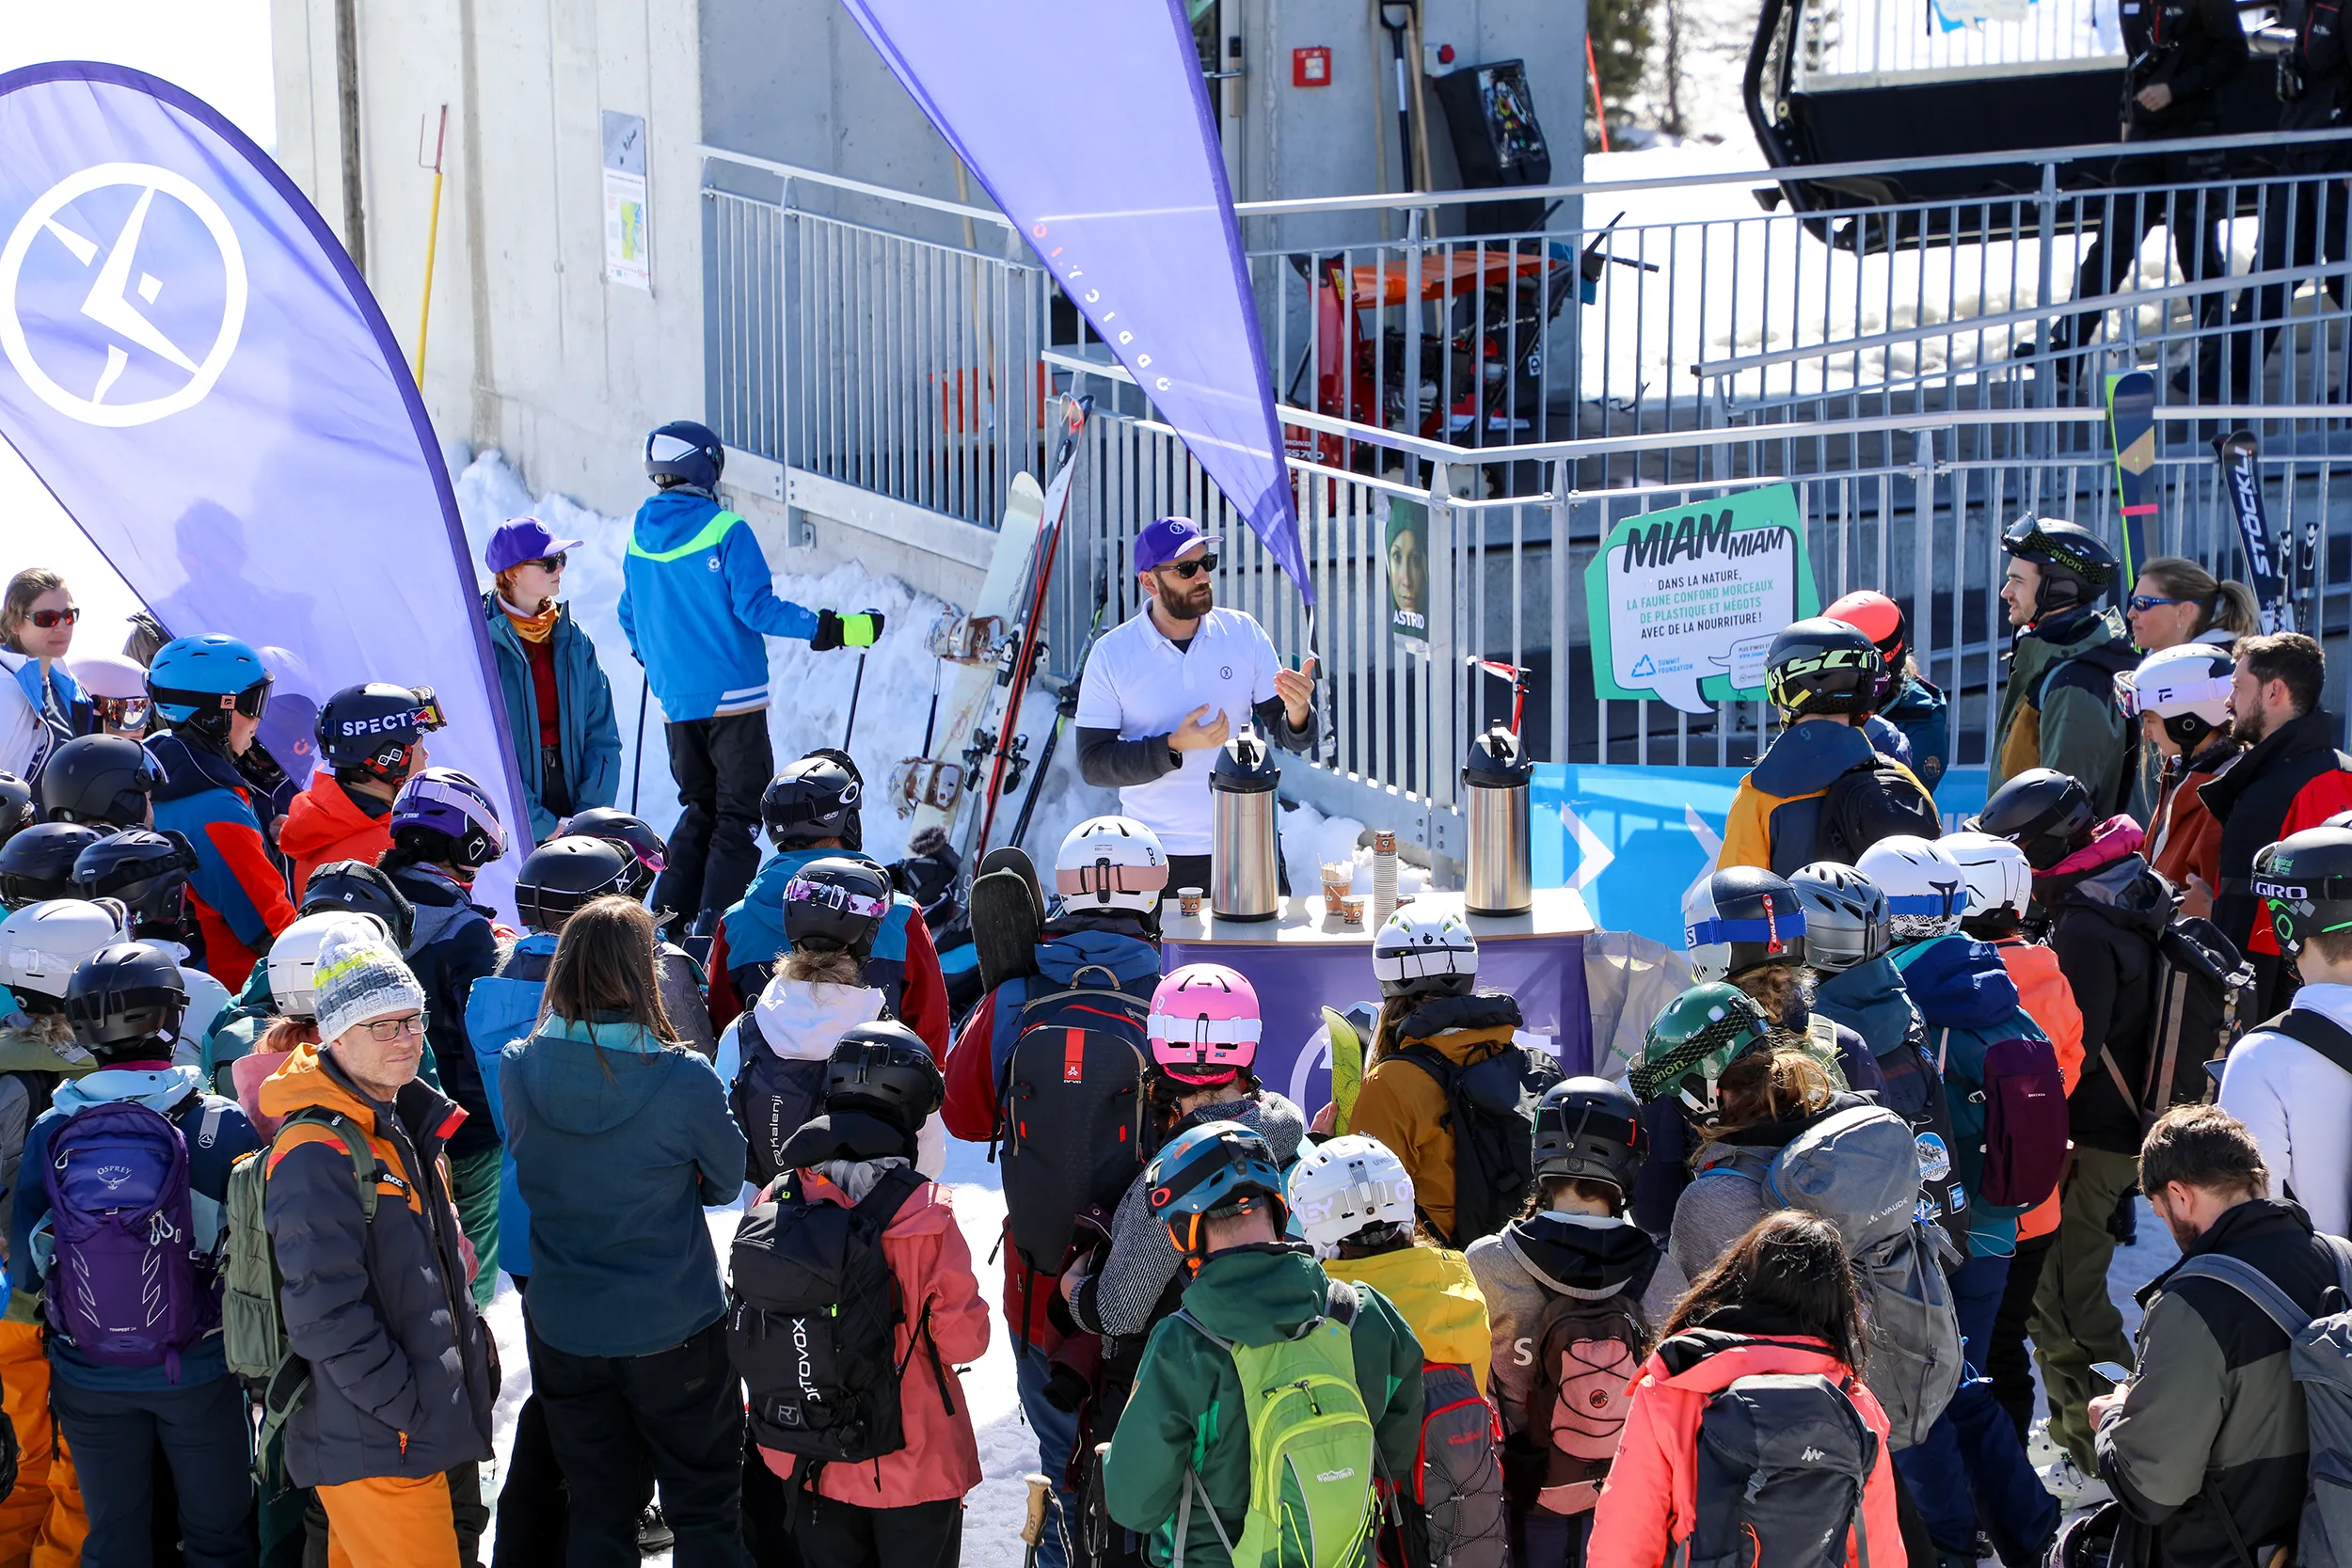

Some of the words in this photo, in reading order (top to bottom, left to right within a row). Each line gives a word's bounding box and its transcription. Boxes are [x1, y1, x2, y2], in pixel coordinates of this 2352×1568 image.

[2234, 446, 2271, 578] STÖCKLI
[1623, 509, 1734, 574] MIAM
[1728, 526, 1785, 560] MIAM
[1658, 576, 1684, 591] DANS
[1687, 575, 1699, 587] LA
[1702, 569, 1742, 585] NATURE,
[1627, 598, 1638, 610] LA
[1641, 594, 1671, 609] FAUNE
[1674, 588, 1719, 604] CONFOND
[1722, 579, 1773, 597] MORCEAUX
[1393, 610, 1424, 630] ASTRID
[1640, 611, 1653, 624] DE
[1655, 604, 1707, 623] PLASTIQUE
[1709, 602, 1720, 614] ET
[1723, 596, 1761, 613] MÉGOTS
[1641, 626, 1665, 640] AVEC
[1668, 623, 1680, 635] DE
[1683, 621, 1694, 633] LA
[1658, 657, 1680, 667] SUMMIT
[1658, 664, 1693, 674] FOUNDATION
[342, 713, 407, 736] SPECT
[2256, 881, 2308, 899] GIRO
[770, 1095, 784, 1148] Kalenji
[97, 1164, 132, 1176] OSPREY
[1373, 1157, 1391, 1166] uvex
[1881, 1196, 1909, 1216] VAUDE
